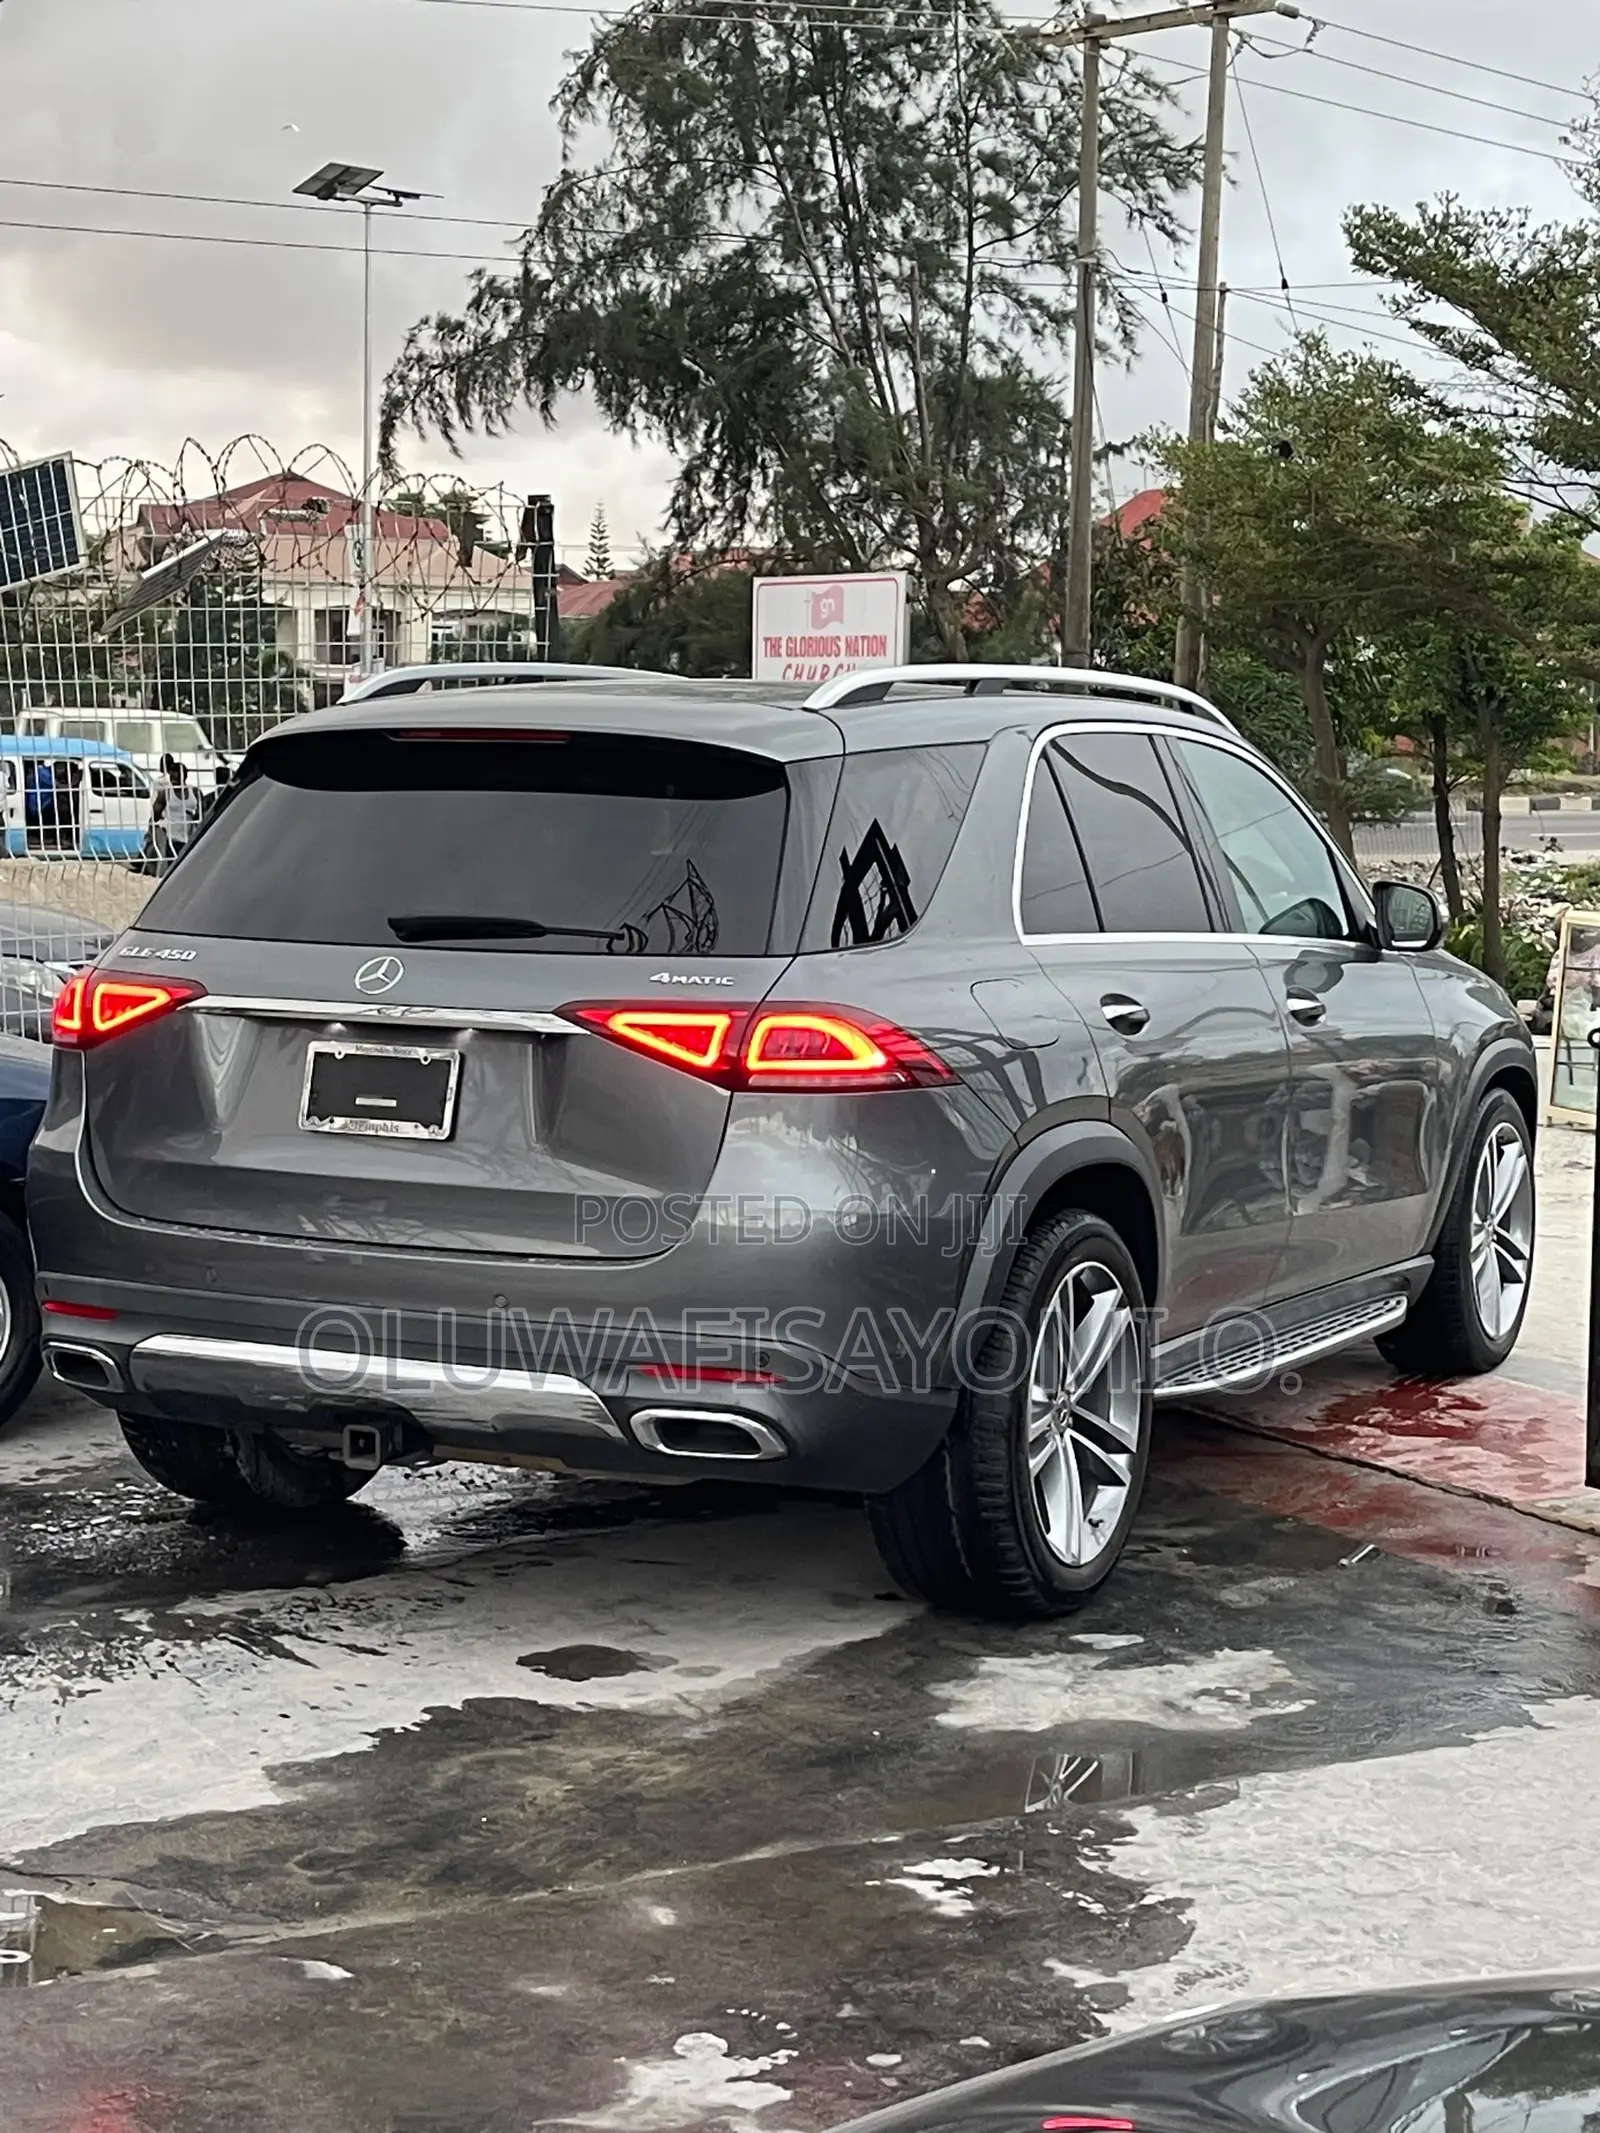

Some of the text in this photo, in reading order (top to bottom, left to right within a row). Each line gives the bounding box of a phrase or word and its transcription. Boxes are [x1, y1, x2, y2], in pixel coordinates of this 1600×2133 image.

[763, 635, 887, 658] THE GLORIOUS NATION
[118, 946, 197, 961] GLE 450
[649, 972, 735, 986] 4MATIC
